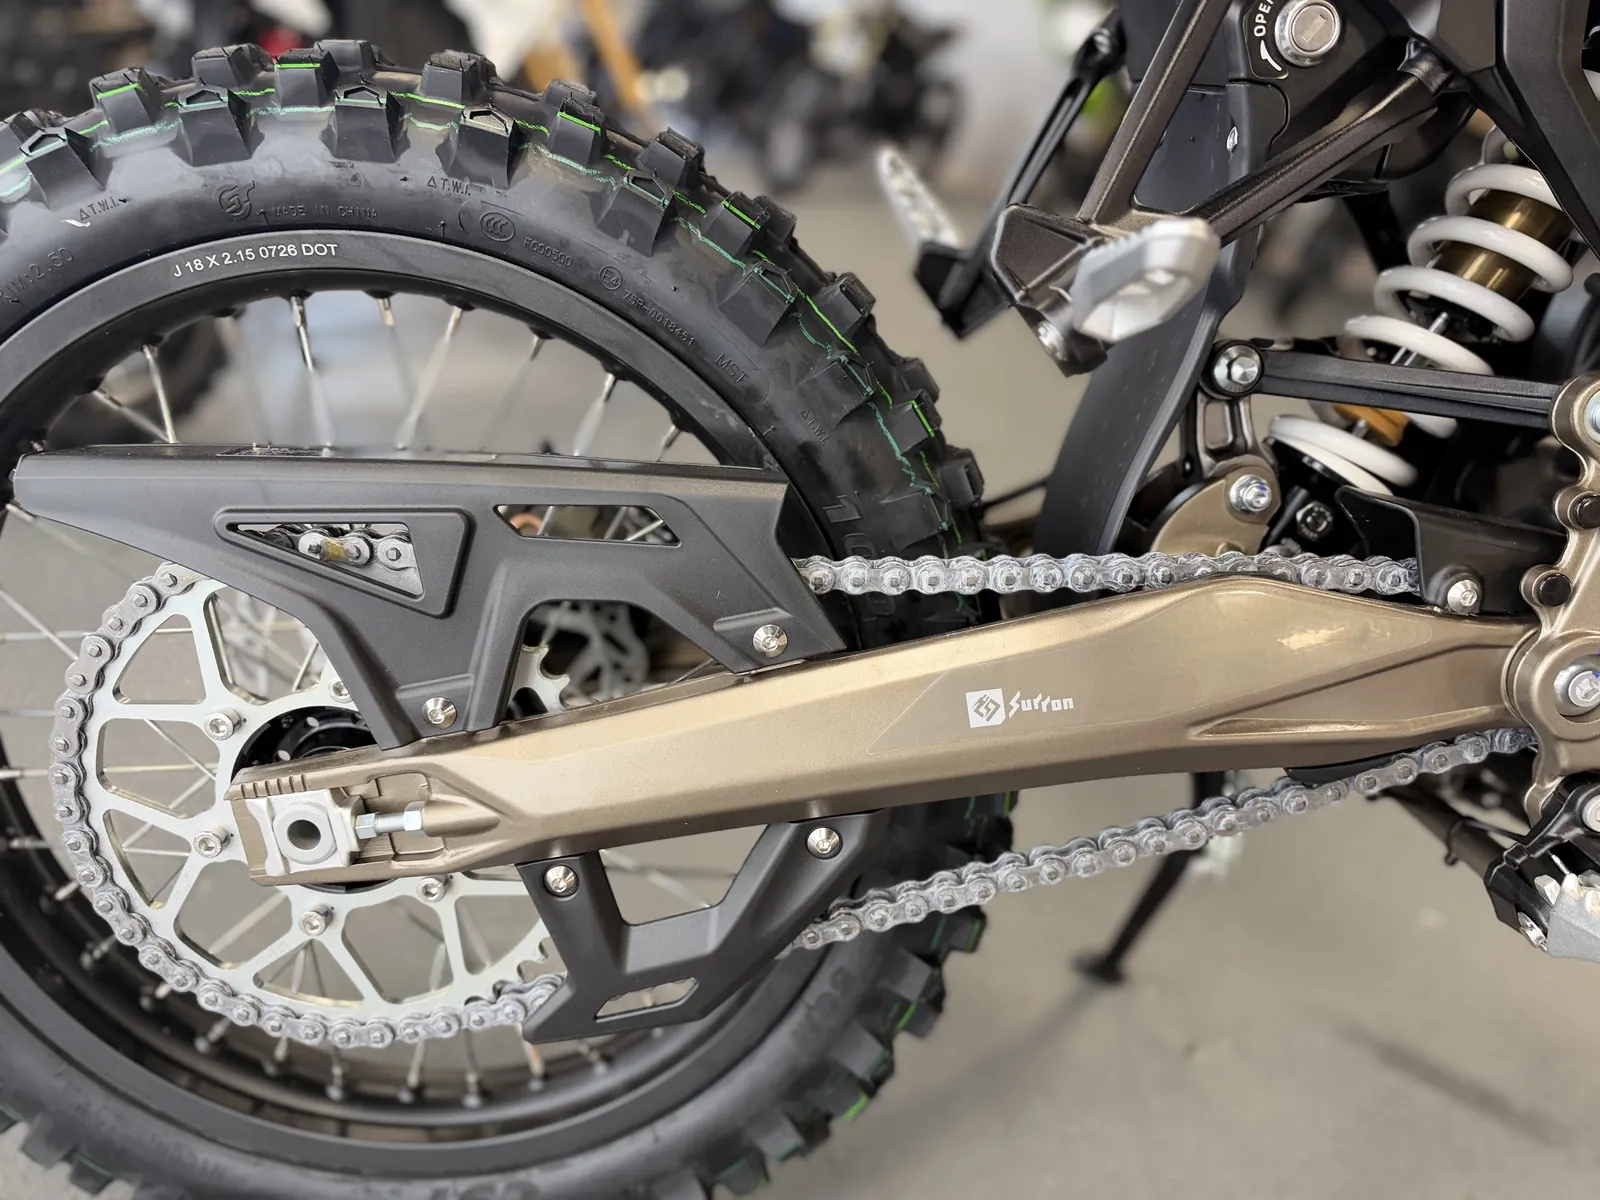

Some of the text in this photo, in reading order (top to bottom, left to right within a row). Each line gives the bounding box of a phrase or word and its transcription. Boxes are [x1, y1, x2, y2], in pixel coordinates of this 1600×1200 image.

[1253, 0, 1276, 37] OPE
[272, 204, 306, 217] MADE
[338, 205, 378, 219] CHINA
[174, 243, 338, 278] J 18 X 2.15 0726 DOT
[715, 352, 750, 384] MST
[1008, 690, 1075, 719] Surron
